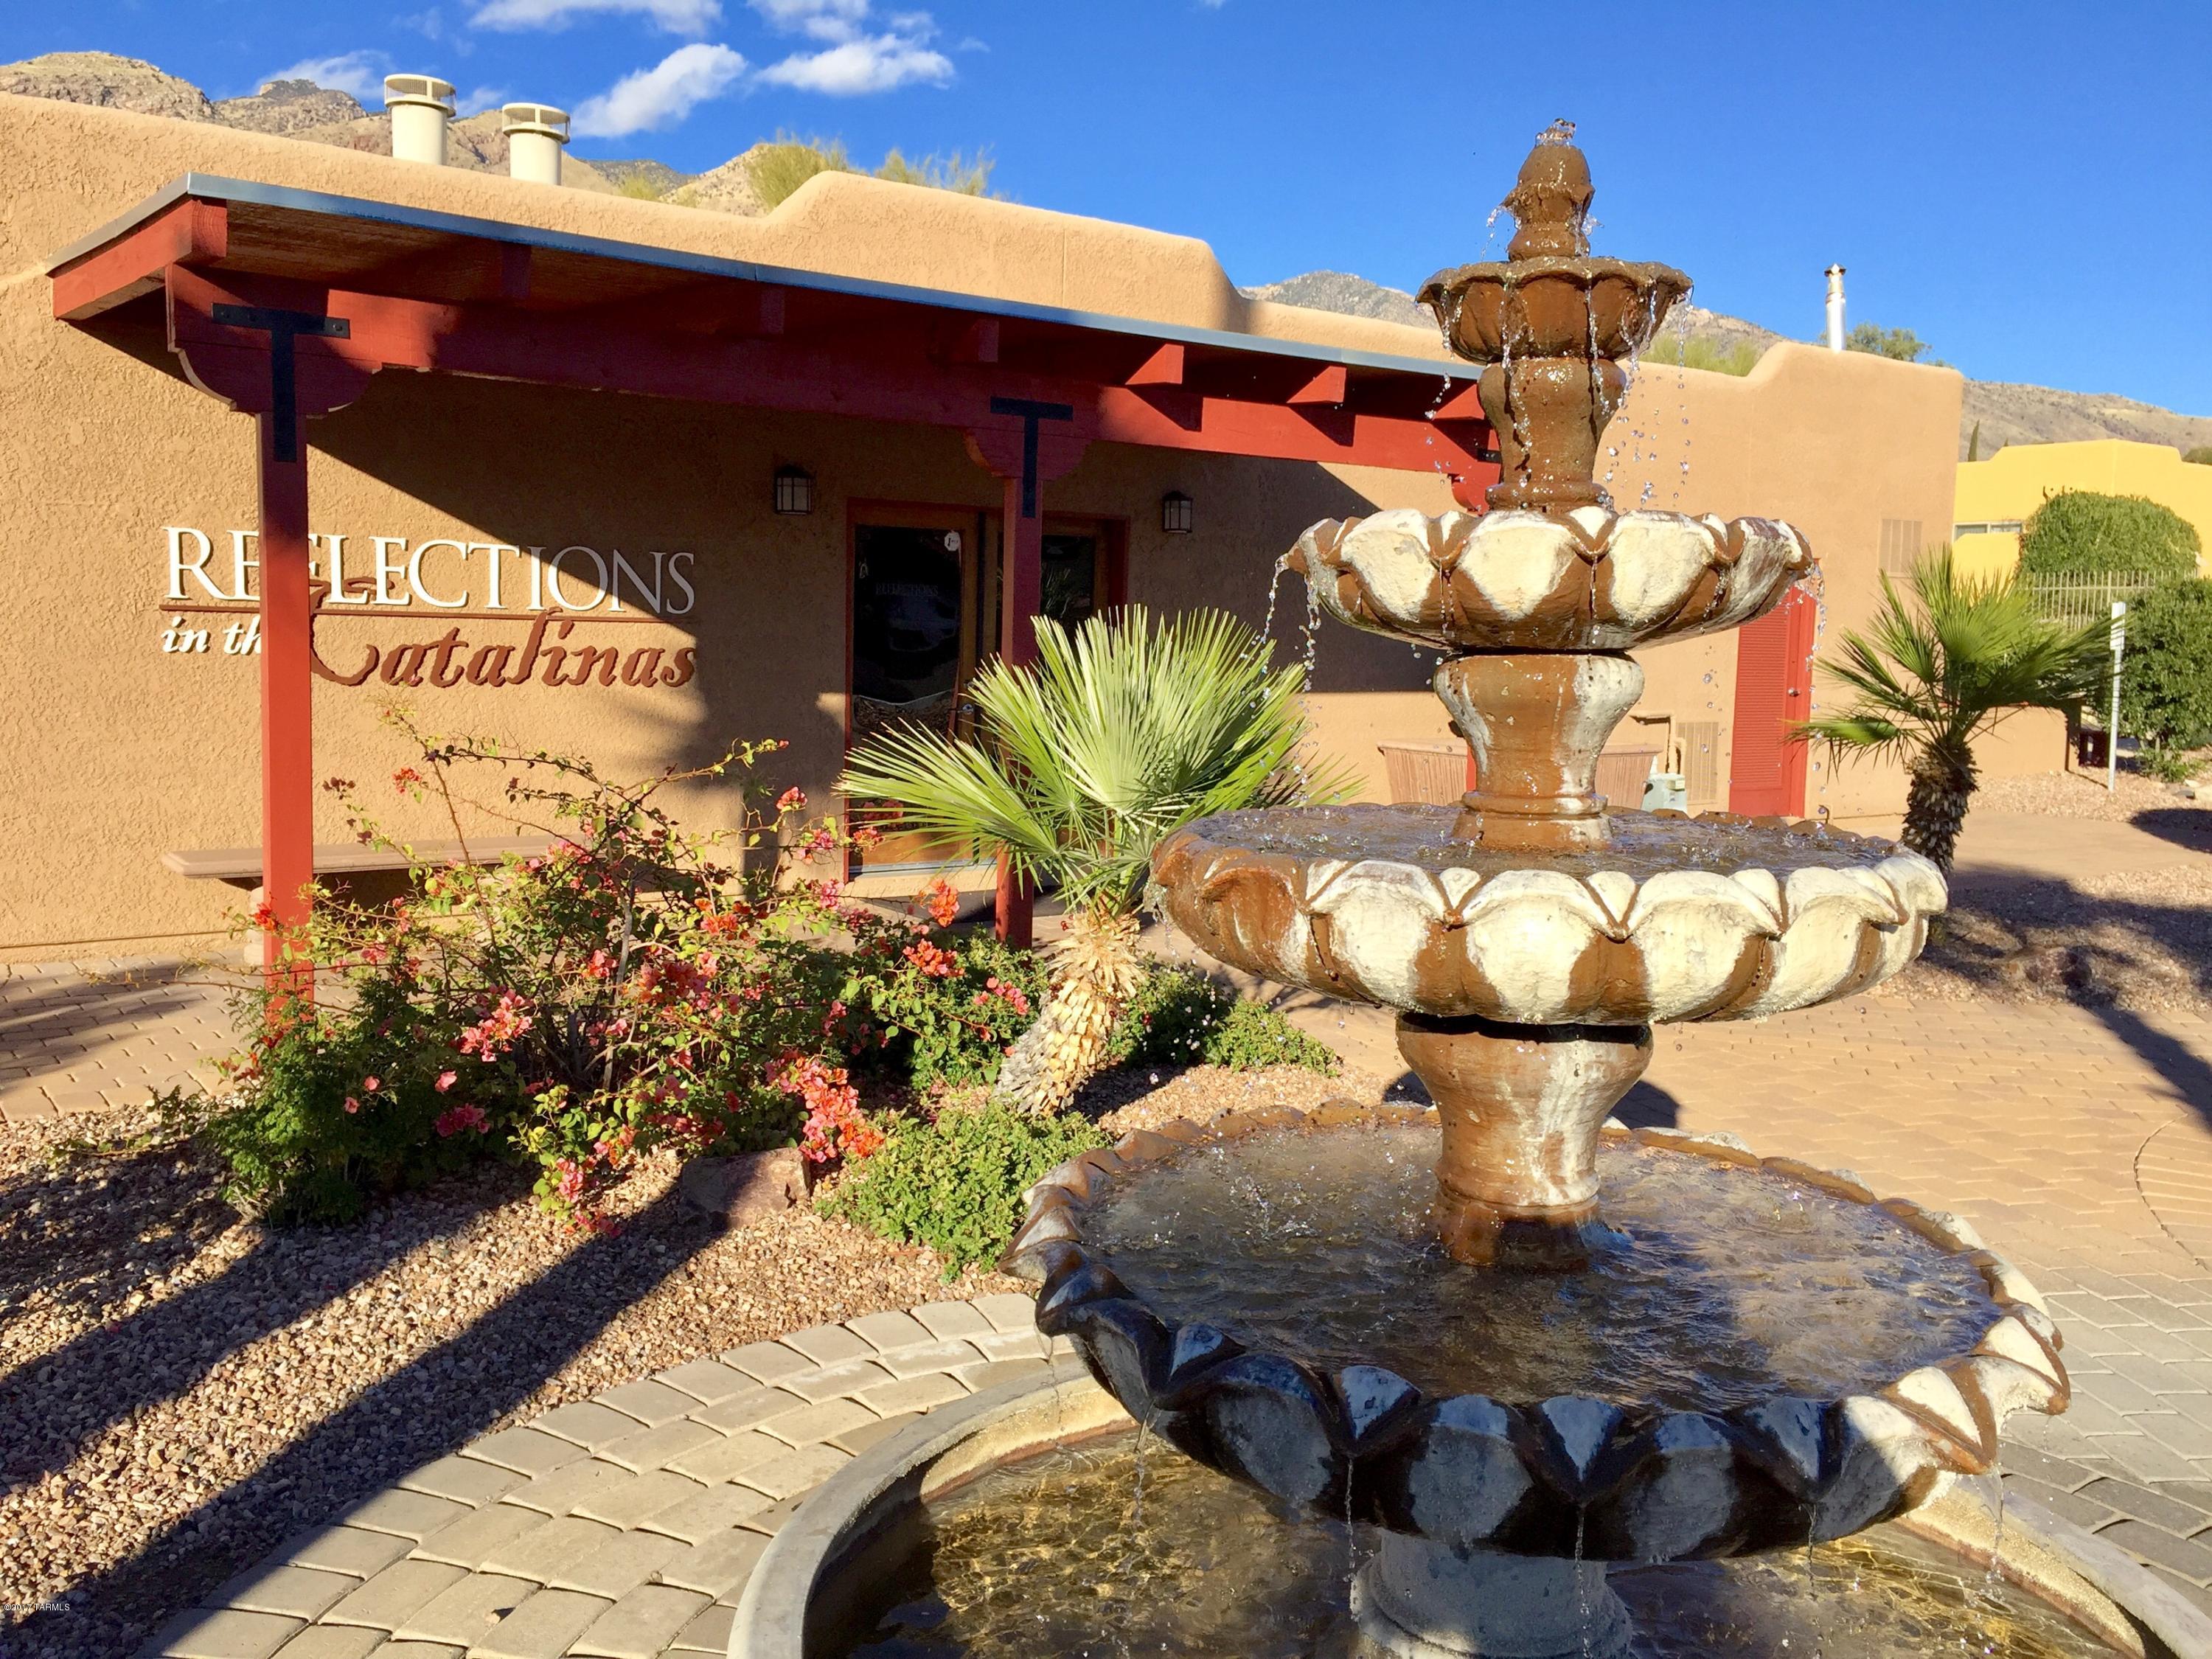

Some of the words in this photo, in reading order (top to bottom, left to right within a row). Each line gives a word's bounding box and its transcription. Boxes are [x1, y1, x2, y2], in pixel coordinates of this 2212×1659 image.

[161, 526, 695, 614] RELECTIONS
[161, 616, 210, 653] in
[223, 615, 262, 655] th
[310, 576, 696, 688] Catalinas
